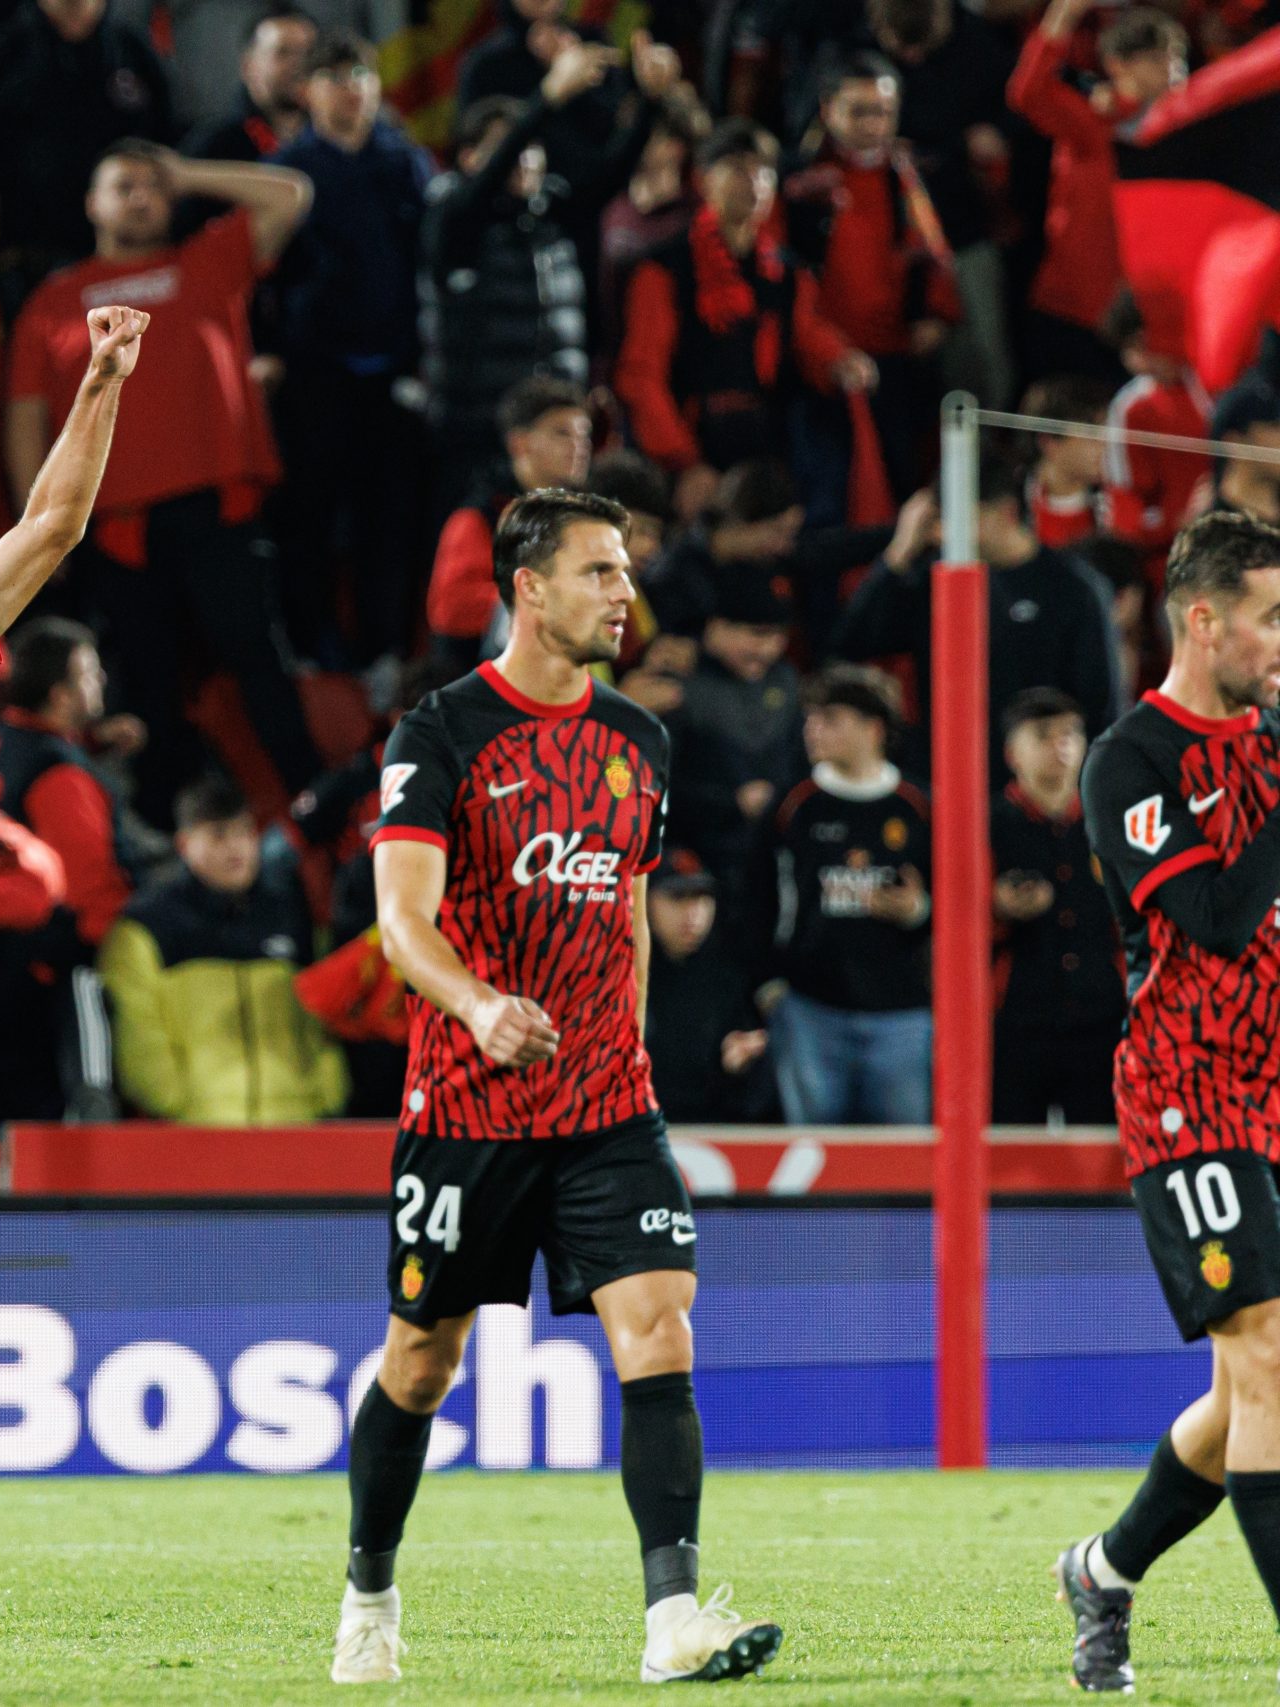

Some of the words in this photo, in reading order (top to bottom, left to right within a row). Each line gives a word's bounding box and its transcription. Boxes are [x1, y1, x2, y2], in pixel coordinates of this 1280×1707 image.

[567, 886, 583, 903] by
[395, 1173, 462, 1253] 24
[1165, 1160, 1242, 1240] 10
